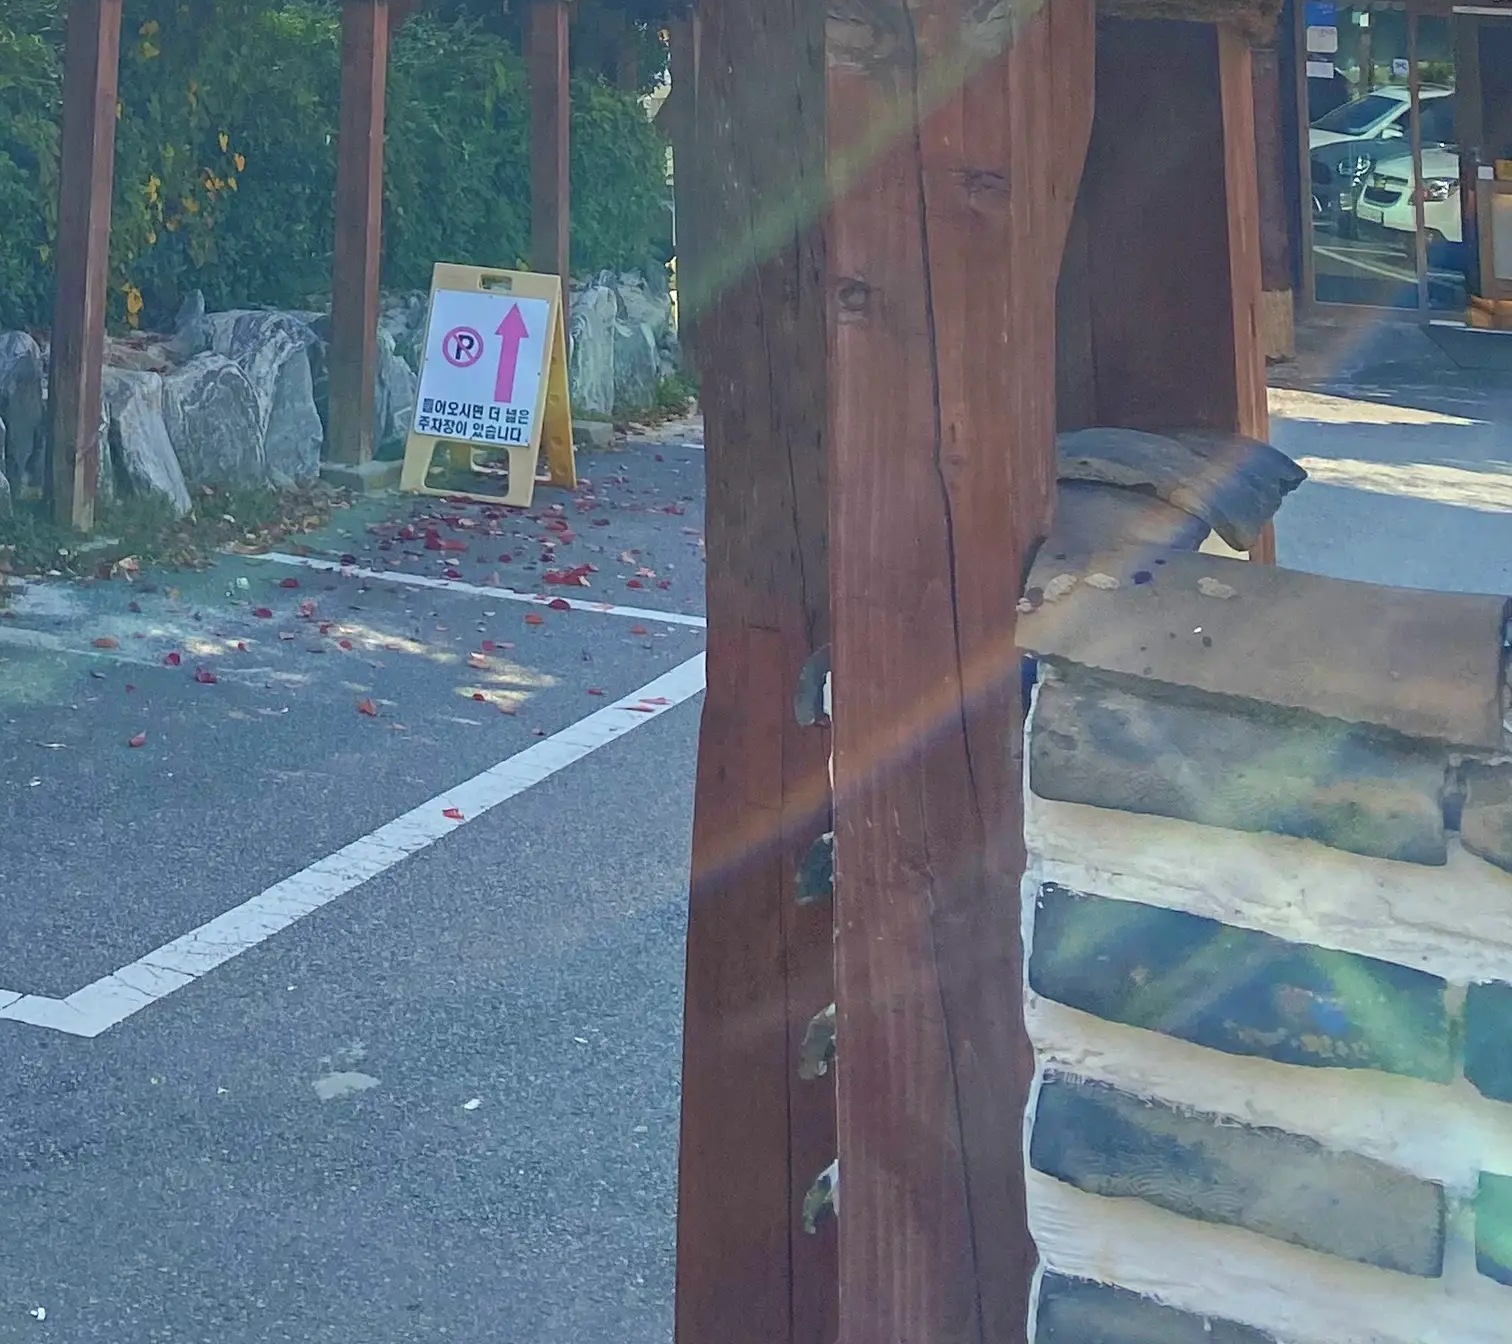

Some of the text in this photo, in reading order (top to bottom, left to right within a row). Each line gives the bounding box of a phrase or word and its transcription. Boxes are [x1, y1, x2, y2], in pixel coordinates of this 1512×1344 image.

[489, 406, 501, 422] 더
[418, 415, 522, 442] 주차장이 있습니다
